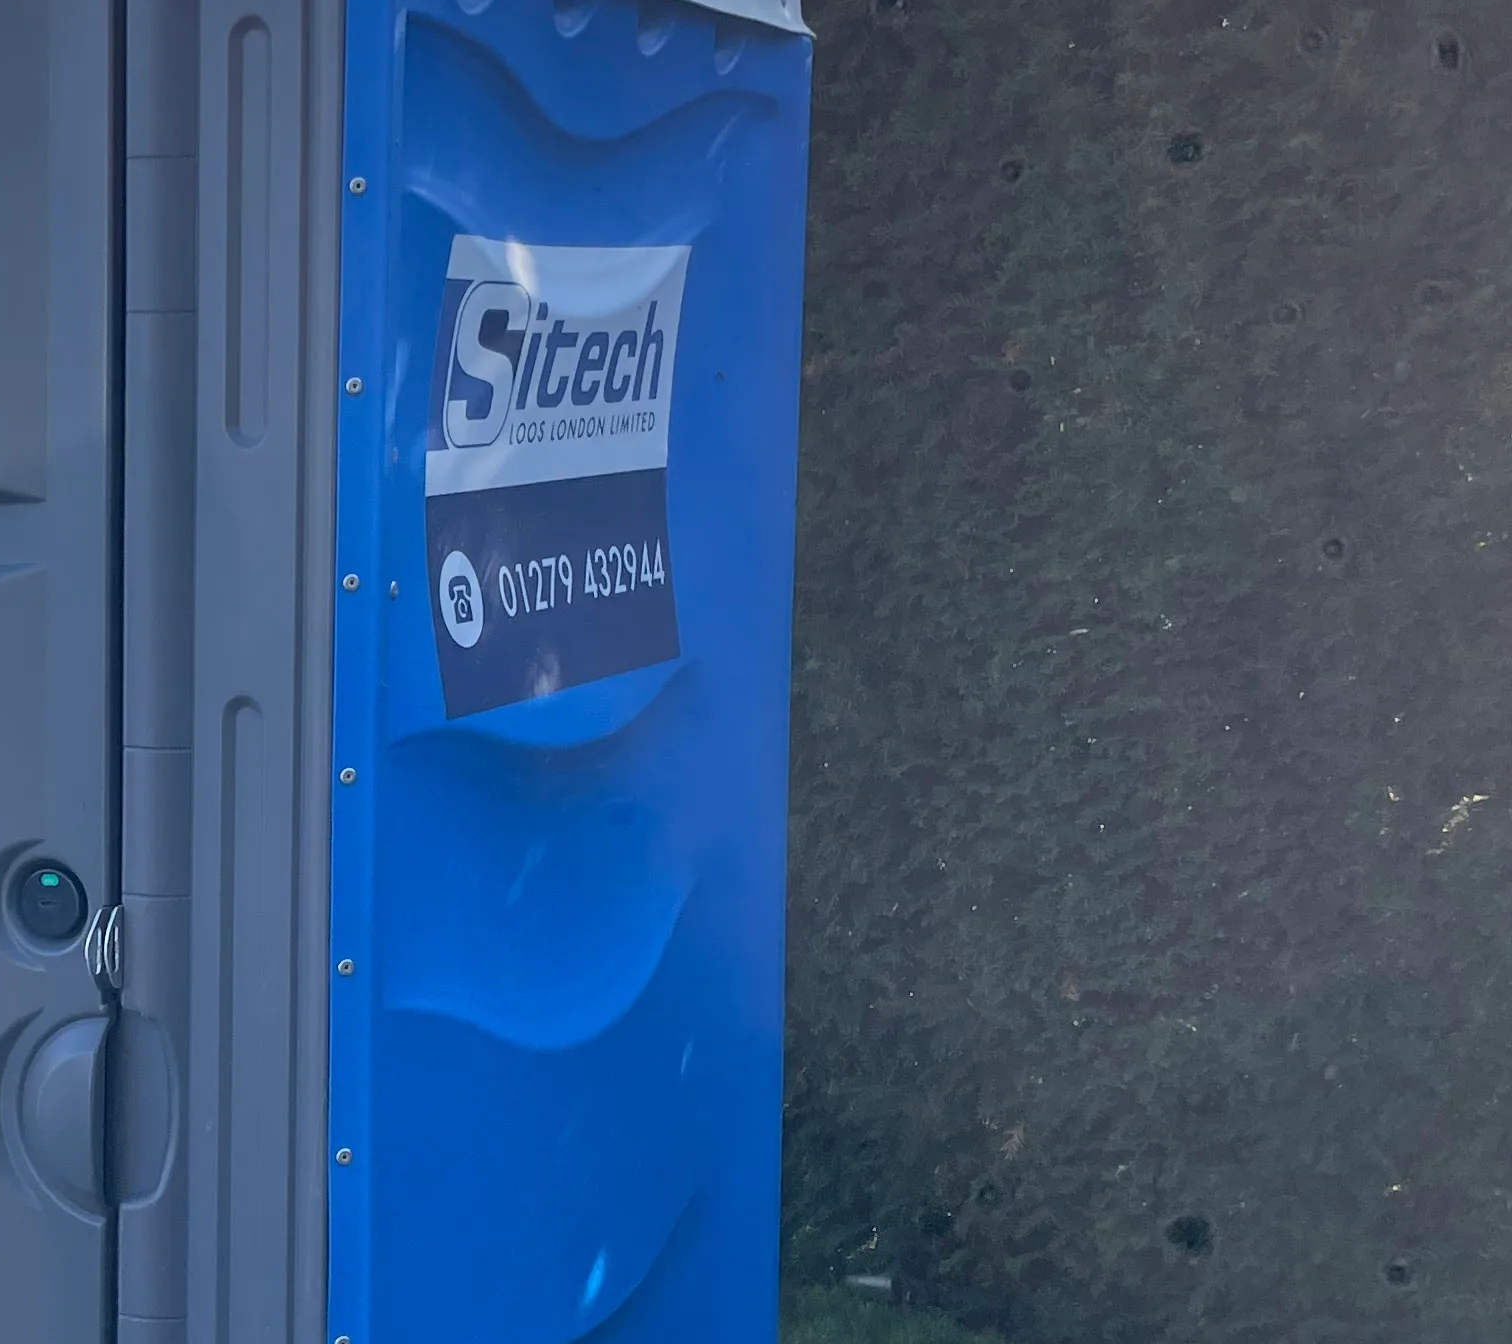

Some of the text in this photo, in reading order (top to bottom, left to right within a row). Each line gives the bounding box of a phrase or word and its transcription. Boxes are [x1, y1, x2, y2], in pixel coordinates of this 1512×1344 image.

[443, 280, 664, 448] Sitech
[509, 411, 656, 445] LOOS LONDON LIMITED
[498, 536, 665, 618] 01279 432944
